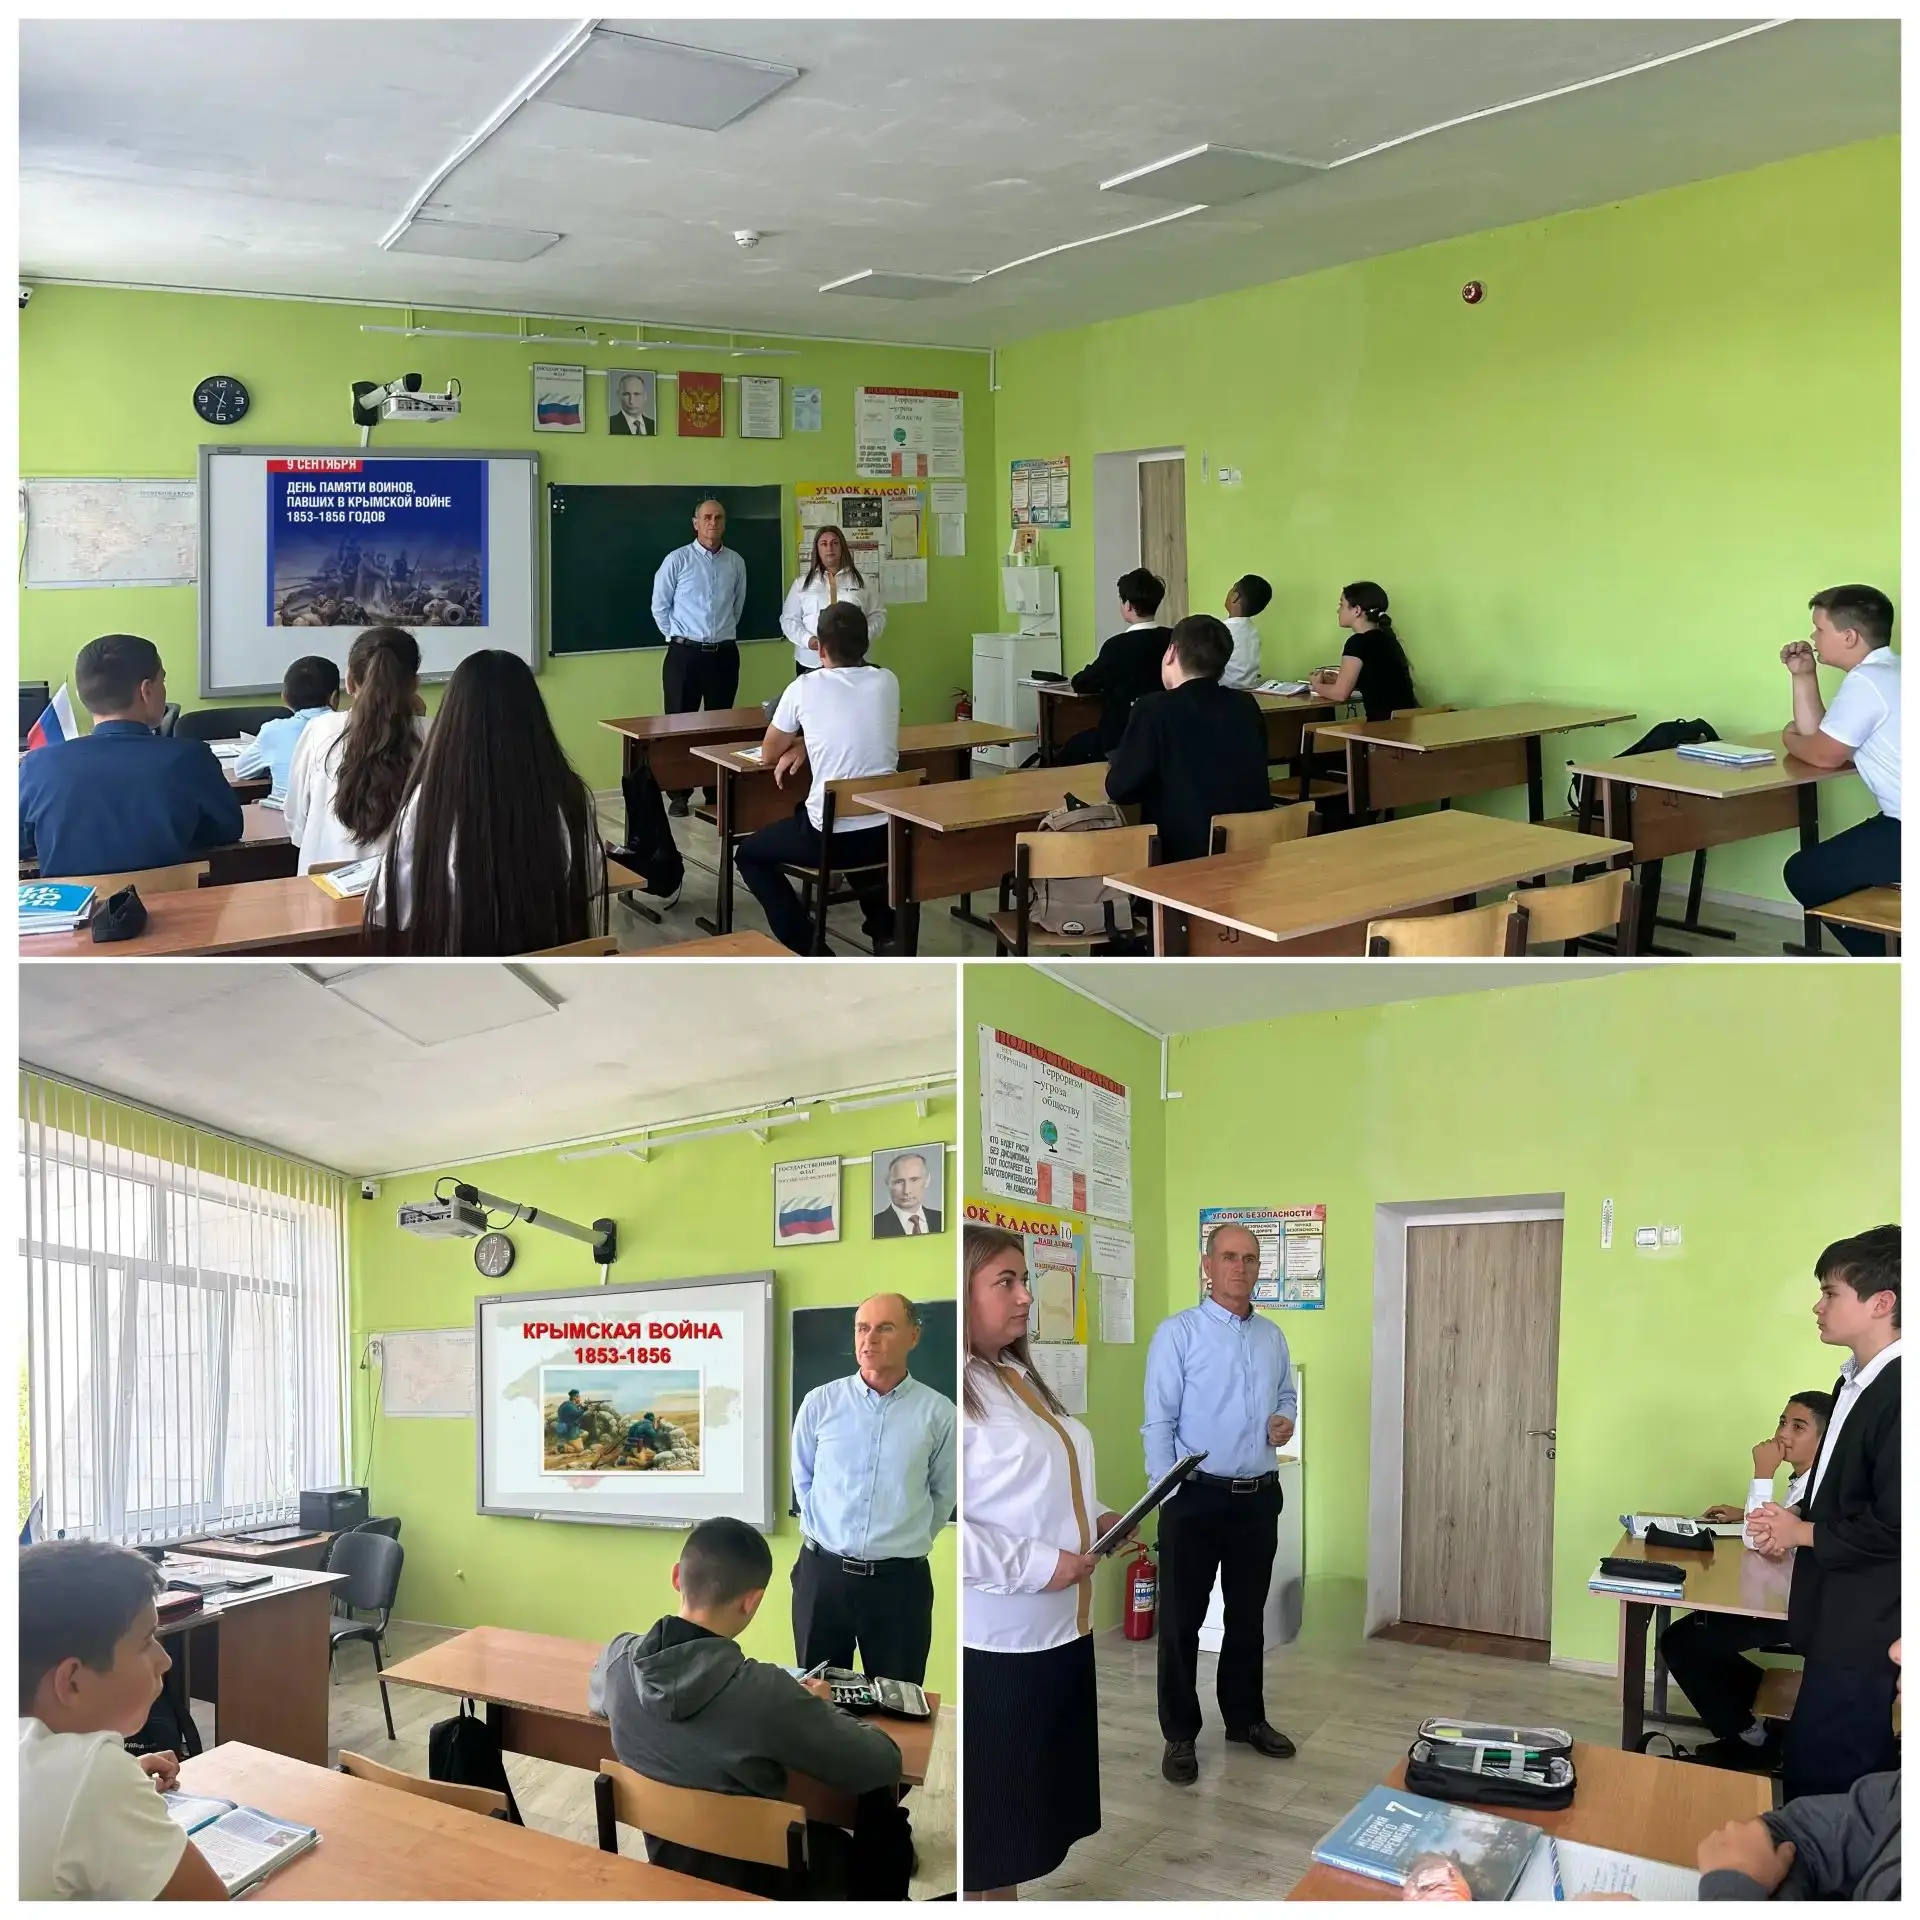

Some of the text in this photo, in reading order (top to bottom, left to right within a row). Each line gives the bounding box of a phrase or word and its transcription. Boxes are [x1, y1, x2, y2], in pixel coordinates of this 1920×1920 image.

[234, 396, 244, 404] 3
[298, 460, 356, 470] СЕНТЯБРЯ
[286, 482, 416, 495] ДЕНЬ ПАМЯТИ ВОИНОВ,
[816, 486, 907, 496] УГОЛОК КЛАССА
[286, 494, 451, 508] ПАВШИХ В КРЫМСКОЙ ВОЙНЕ
[286, 511, 386, 524] 1853-1856 ГОДОВ
[1000, 1030, 1077, 1076] ПОДРОСТОК
[1086, 1069, 1124, 1096] ЗАКОН
[1041, 1062, 1083, 1090] Терроризм
[1042, 1096, 1080, 1118] обществу
[990, 1146, 999, 1156] БЕЗ
[778, 1160, 837, 1172] ГОСУДАРСТВЕННЫЙ
[988, 1156, 997, 1165] ТОТ
[1212, 1210, 1312, 1220] УГОЛОК БЕЗОПАСНОСТИ
[996, 1213, 1058, 1236] КЛАССА
[1060, 1226, 1072, 1240] 10
[524, 1320, 724, 1339] КРЫМСКАЯ ВОЙНА
[574, 1348, 672, 1364] 1853-1856
[1384, 1800, 1422, 1818] 7
[1354, 1816, 1389, 1848] ИСТОРИЯ
[1367, 1824, 1398, 1851] НОВОГО
[1380, 1822, 1414, 1856] ВРЕМЕНИ
